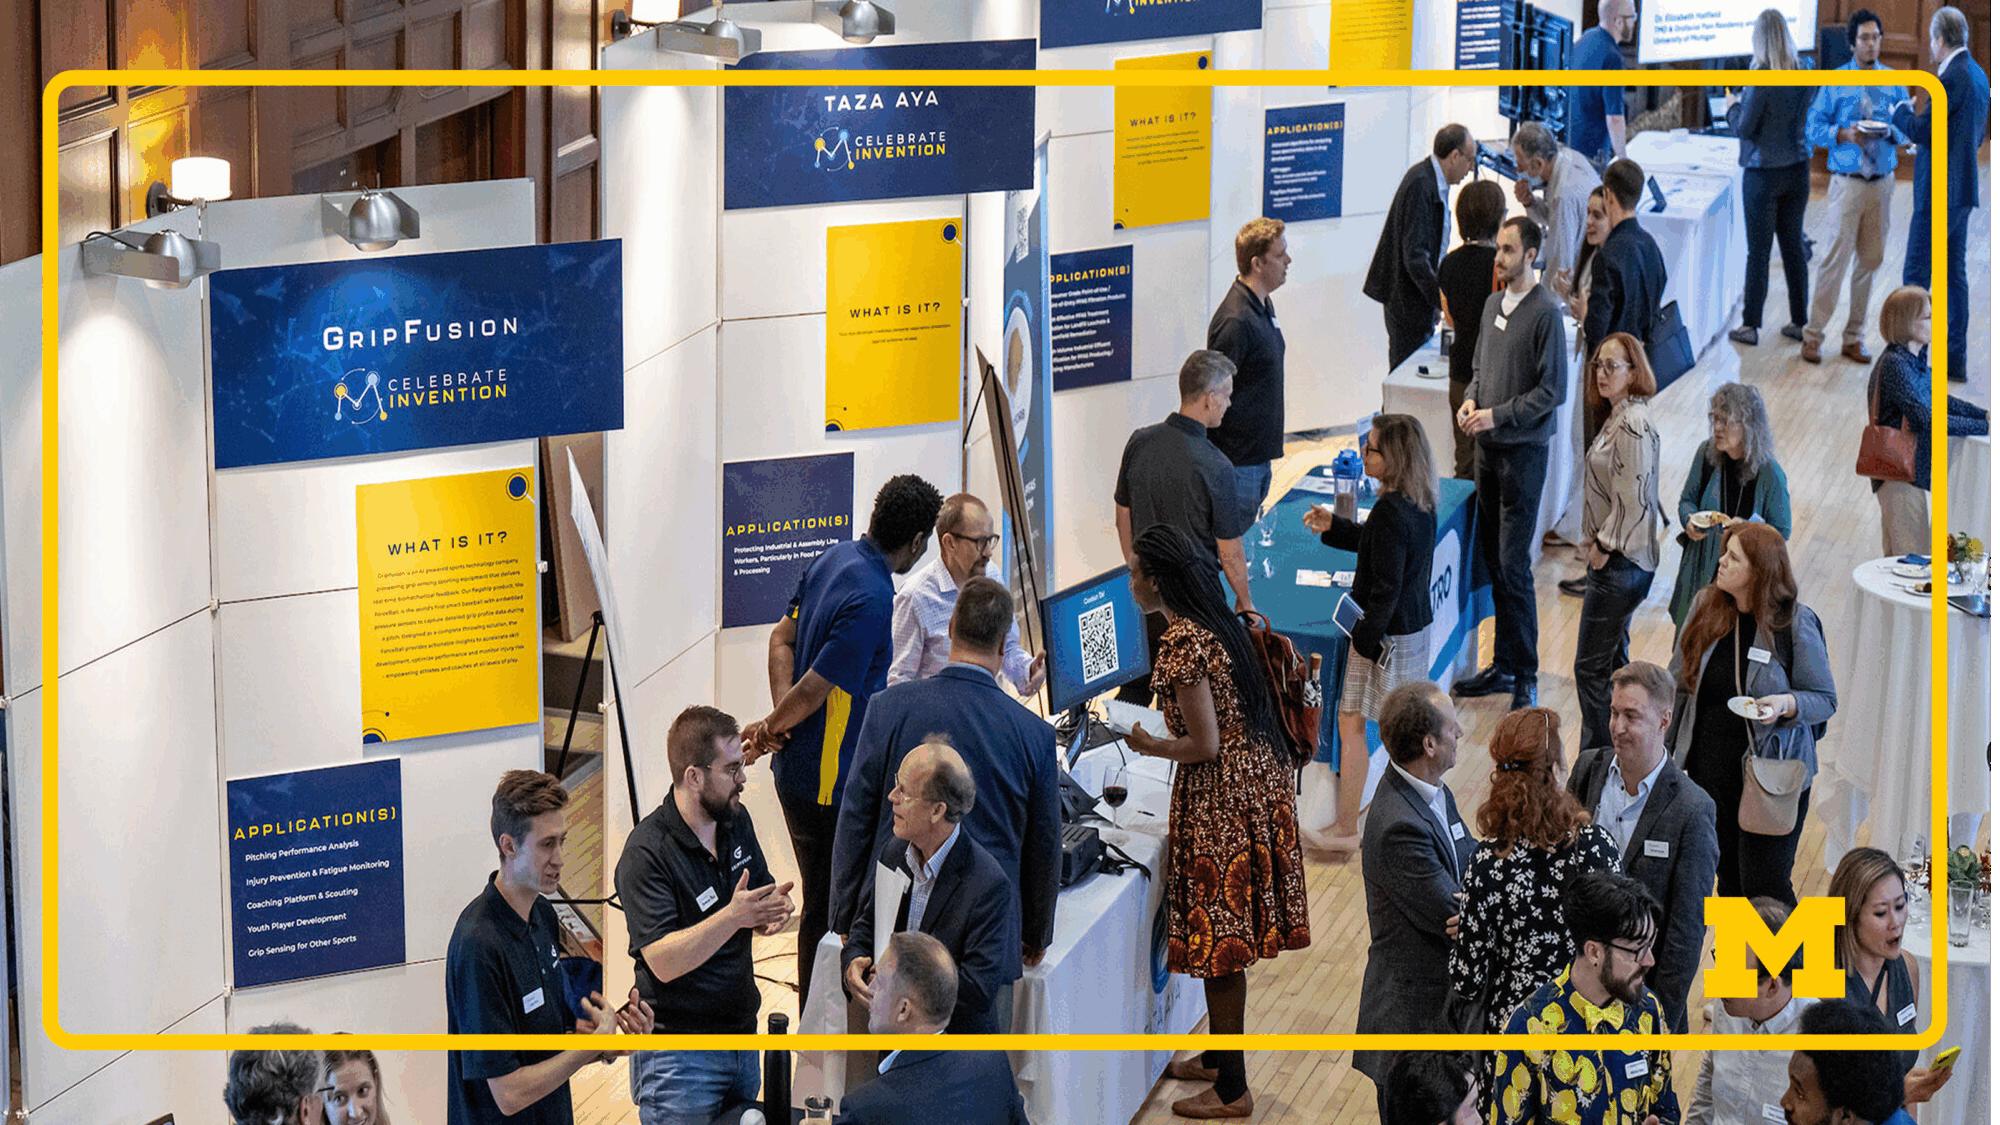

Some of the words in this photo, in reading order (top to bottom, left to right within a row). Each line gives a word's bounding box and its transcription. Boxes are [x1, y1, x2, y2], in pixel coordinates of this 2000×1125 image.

[824, 92, 884, 113] TAZA
[895, 90, 939, 108] AYA
[1130, 115, 1159, 127] WHAT
[1164, 113, 1175, 123] IS
[1179, 111, 1197, 122] IT?
[855, 131, 946, 147] CELEBRATE
[856, 143, 946, 161] INVENTION
[1050, 264, 1131, 283] PPLICATION(S)
[850, 305, 890, 318] WHAT
[897, 304, 911, 315] IS
[918, 302, 940, 313] IT?
[388, 368, 508, 392] CELEBRATE
[389, 384, 508, 409] INVENTION
[726, 514, 849, 537] APPLICATION(S)
[388, 538, 441, 556] WHAT
[451, 535, 469, 549] IS
[478, 531, 508, 546] IT?
[1430, 564, 1452, 613] TRO
[234, 806, 396, 841] APPLICATION(S)
[245, 853, 277, 861] Pitching
[279, 846, 327, 856] Performance
[329, 841, 360, 849] Analysis
[246, 878, 269, 886] Injury
[270, 872, 311, 881] Prevention
[319, 867, 348, 875] Fatigue
[349, 861, 390, 870] Monitoring
[247, 900, 283, 909] Coaching
[284, 895, 317, 903] Platform
[325, 889, 359, 898] Scouting
[297, 914, 347, 926] Development
[266, 945, 296, 954] Sensing
[310, 940, 331, 948] Other
[333, 936, 357, 944] Sports
